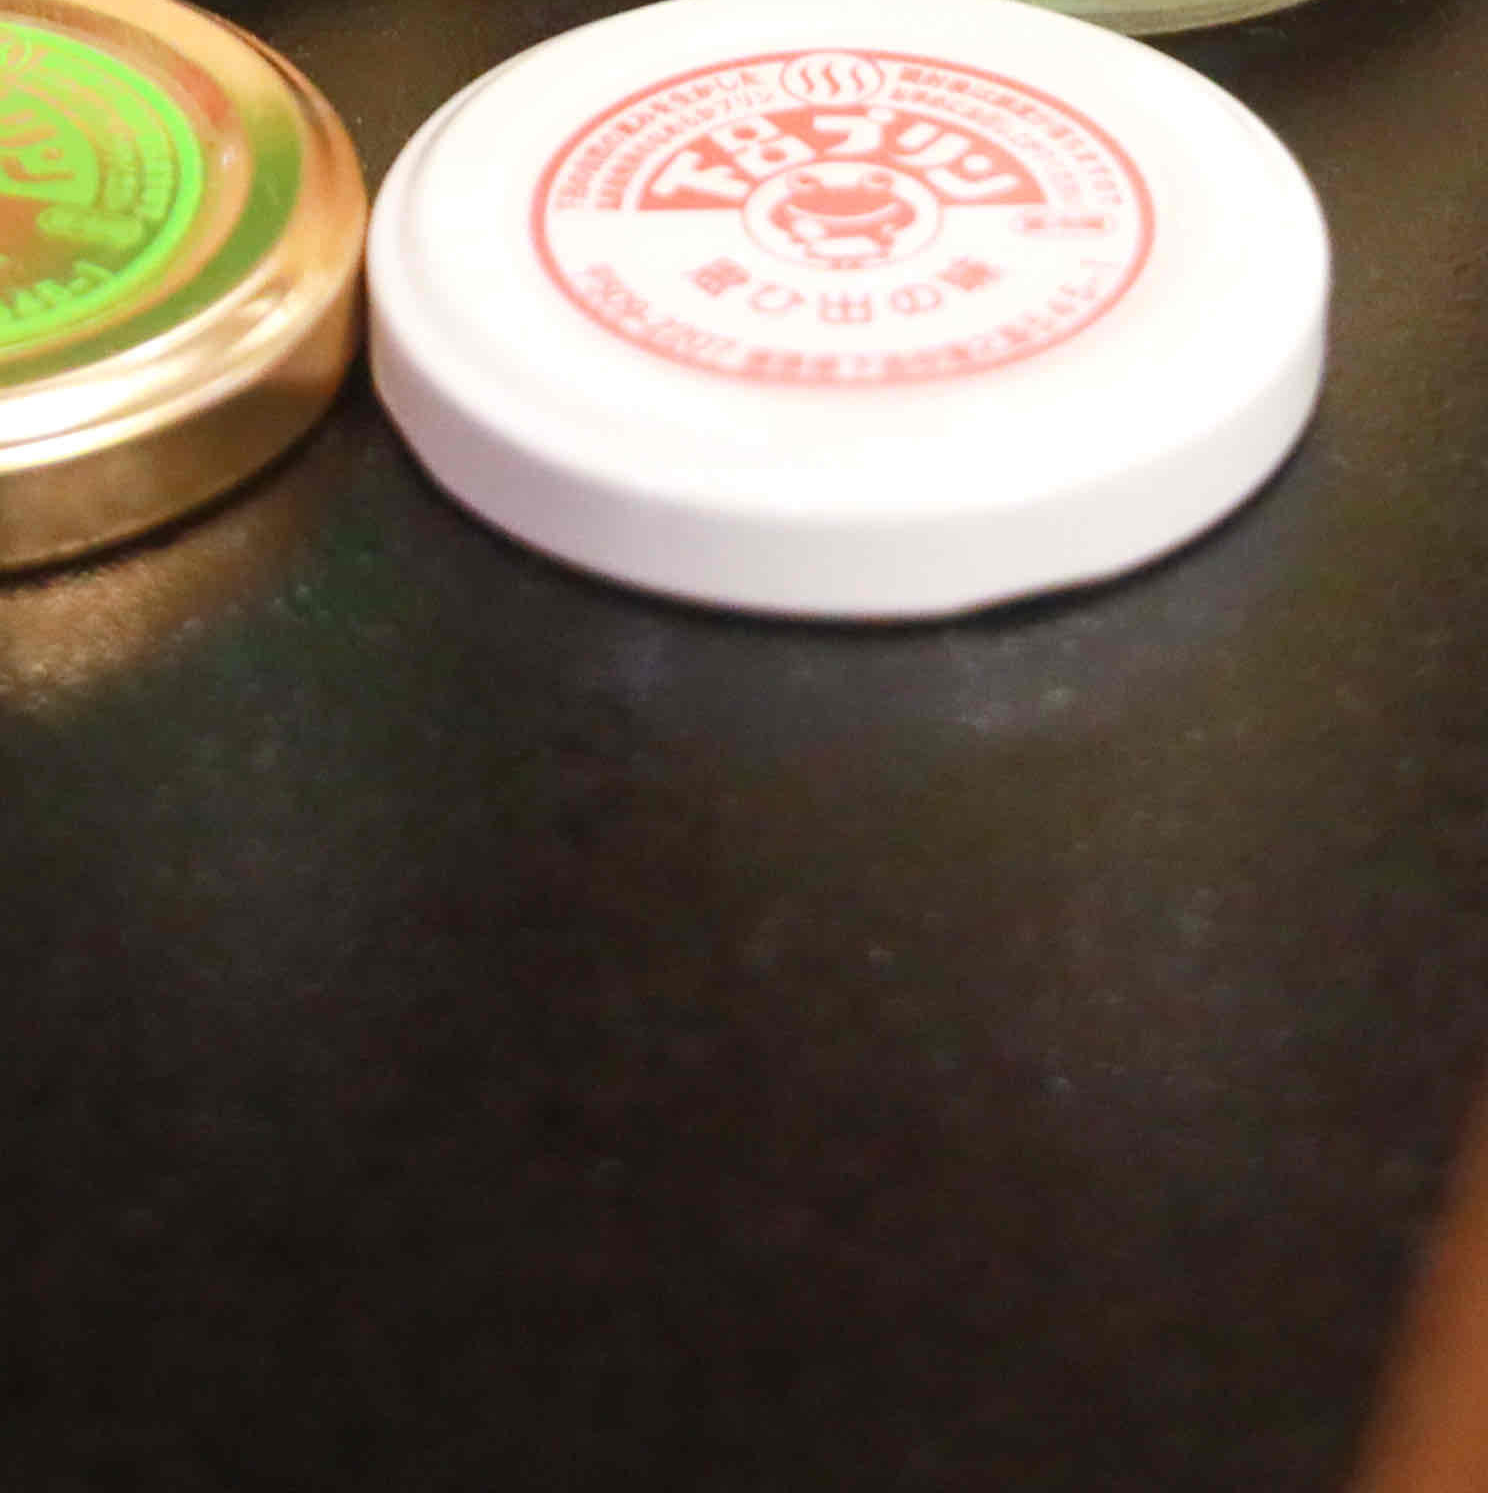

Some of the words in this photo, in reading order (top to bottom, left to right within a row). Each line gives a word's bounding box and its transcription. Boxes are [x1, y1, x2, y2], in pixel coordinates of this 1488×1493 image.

[650, 108, 1023, 200] 下呂プリン
